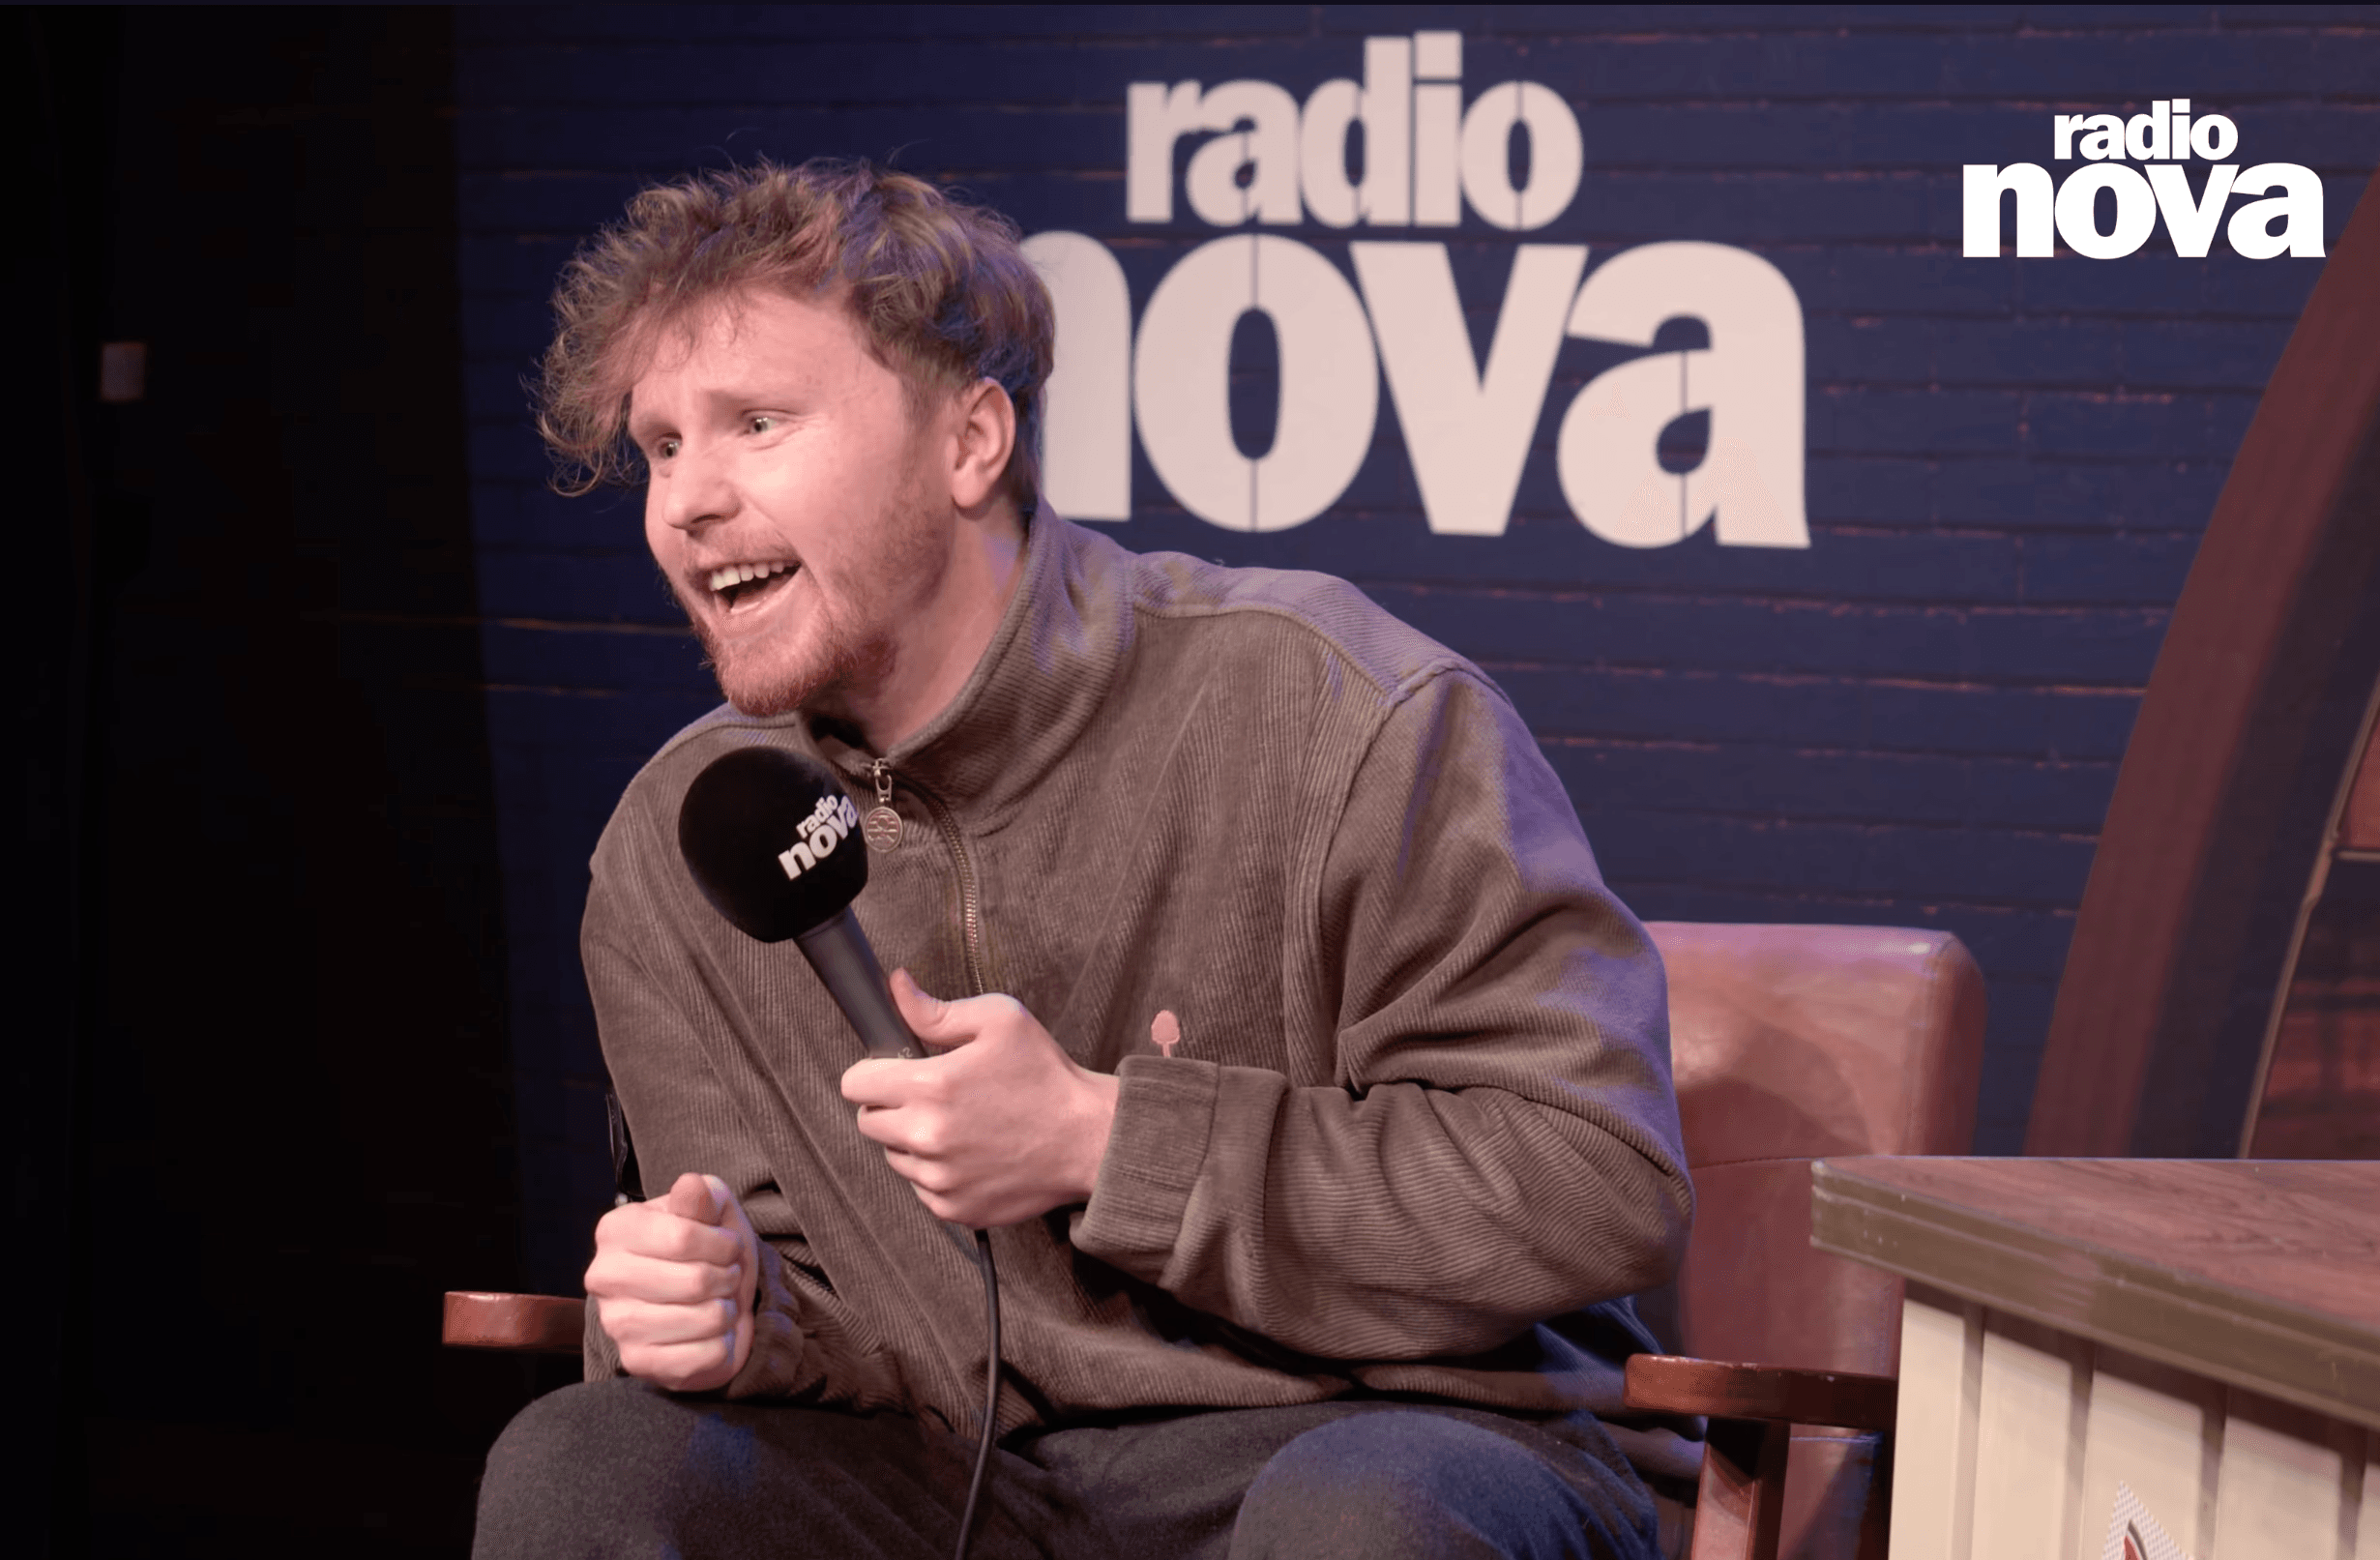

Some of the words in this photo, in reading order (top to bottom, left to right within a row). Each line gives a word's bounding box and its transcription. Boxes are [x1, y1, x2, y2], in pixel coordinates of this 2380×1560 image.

[1128, 32, 1583, 230] radio
[778, 795, 859, 880] nova
[796, 794, 838, 839] radio
